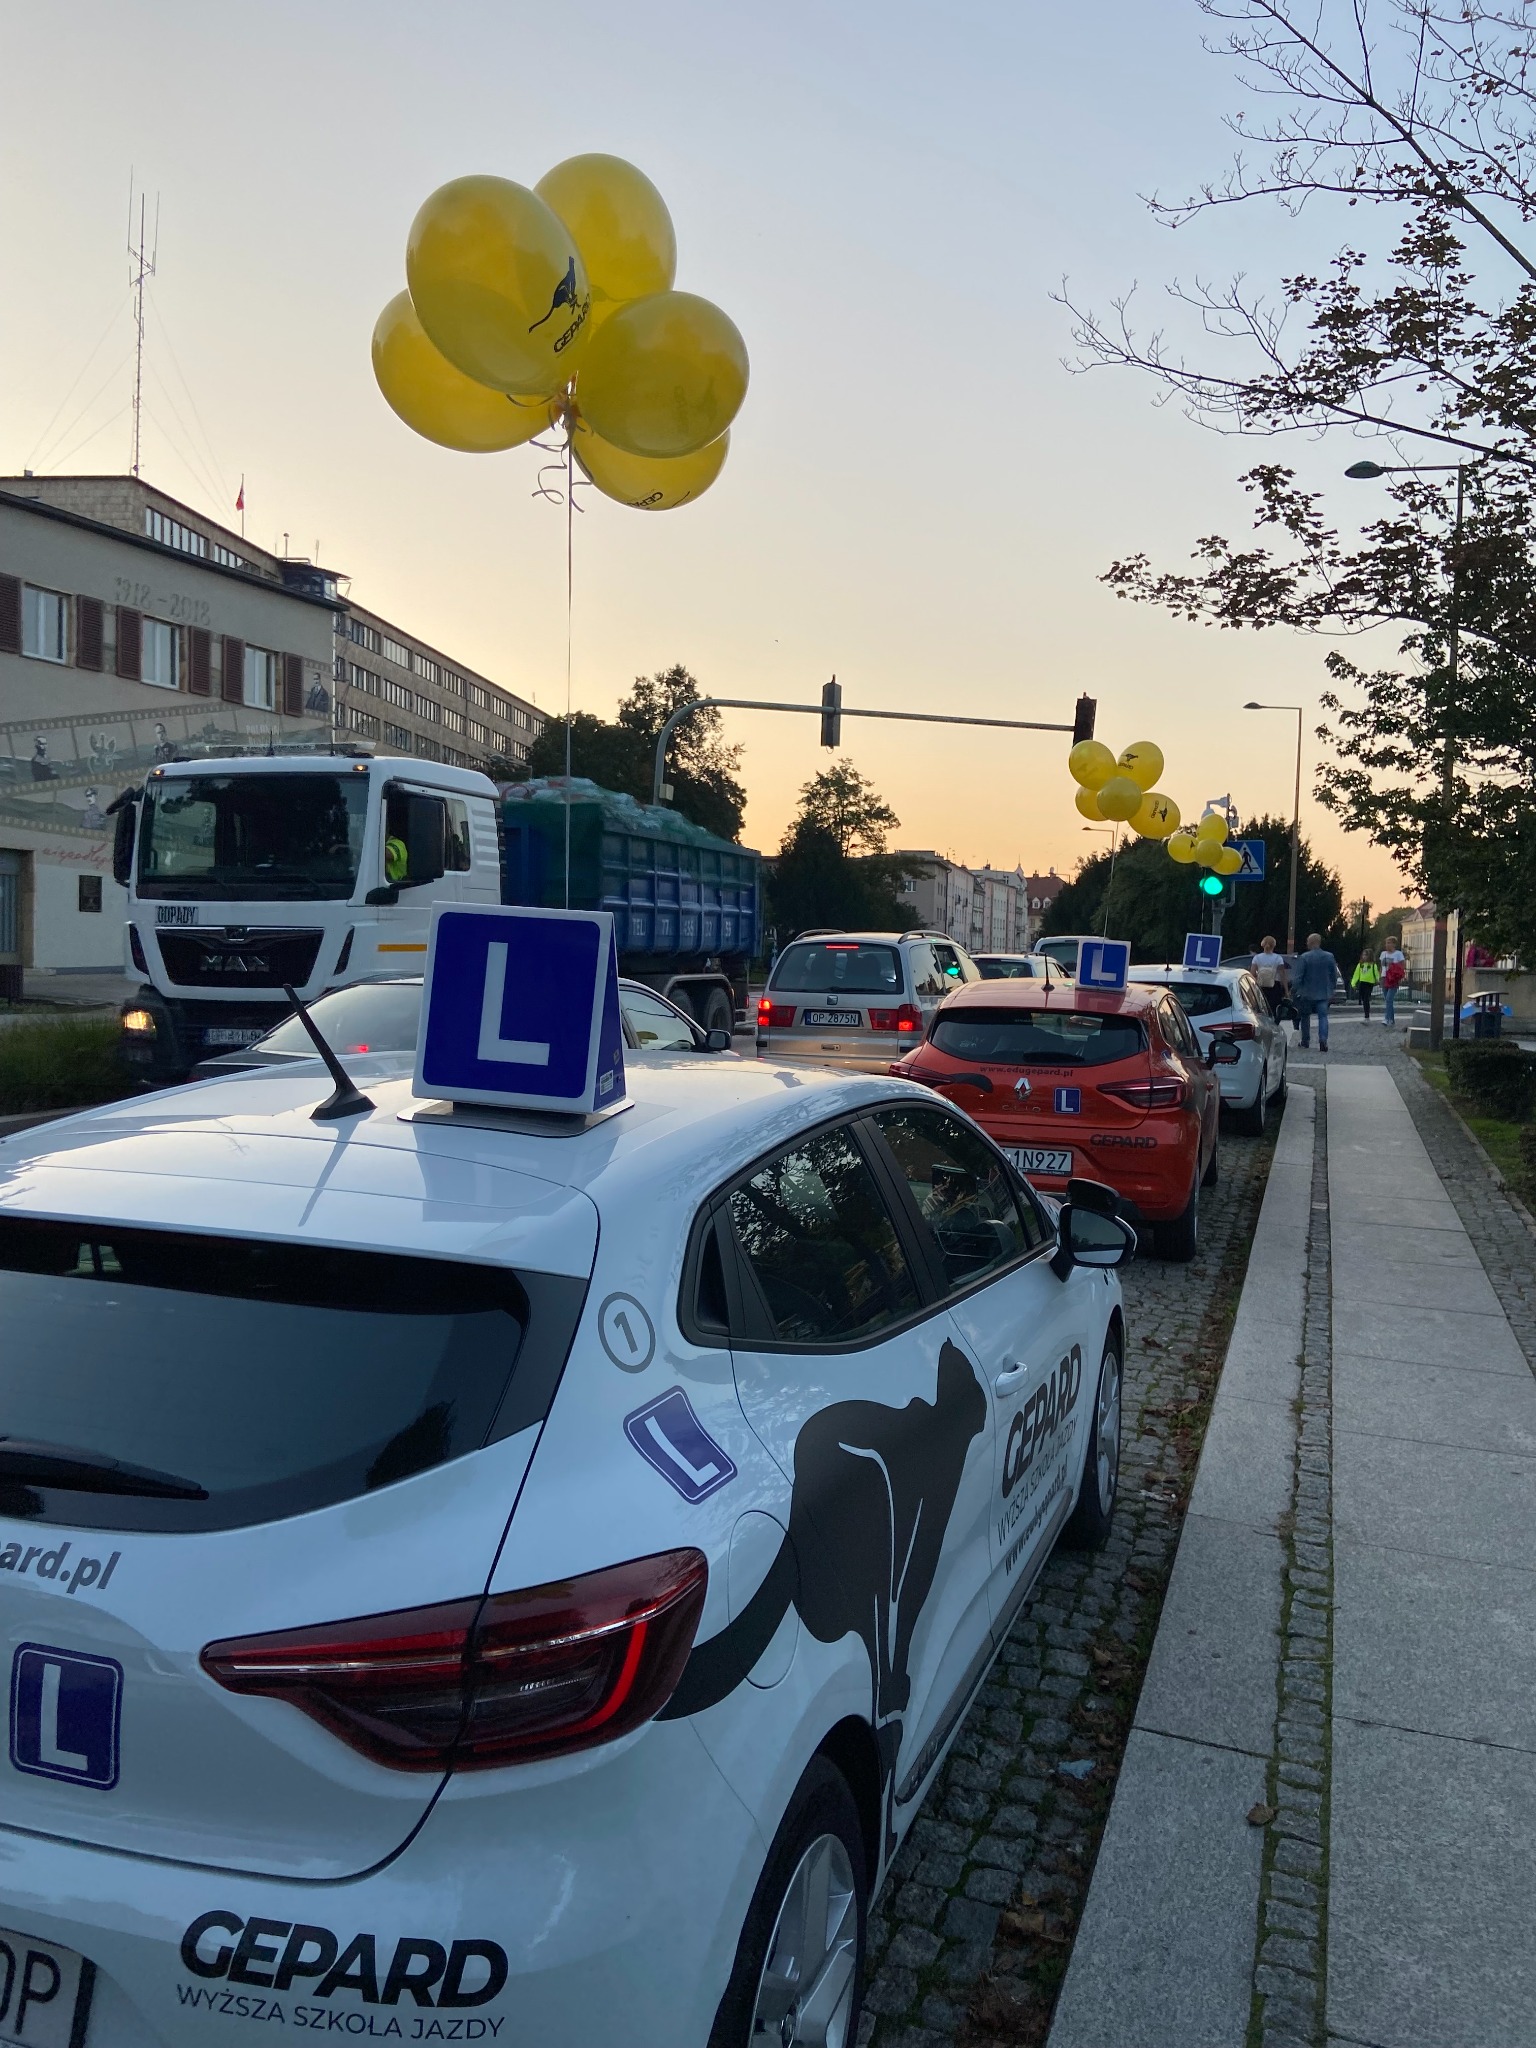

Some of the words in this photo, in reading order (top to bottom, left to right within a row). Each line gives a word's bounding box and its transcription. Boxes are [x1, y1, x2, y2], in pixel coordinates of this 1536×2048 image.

[157, 905, 196, 924] ODPADY
[201, 955, 270, 972] MAN
[1090, 949, 1117, 982] L
[1195, 940, 1211, 963] L
[477, 942, 551, 1066] L
[812, 1013, 825, 1023] OP
[828, 1014, 857, 1024] 2875N
[980, 1065, 1074, 1078] www.edugepard.pl
[1002, 1104, 1042, 1113] CLIO
[1060, 1090, 1074, 1112] L
[1090, 1133, 1158, 1149] GEPARD
[613, 1311, 639, 1354] 1
[1002, 1342, 1081, 1499] GEPARD
[644, 1415, 721, 1488] L
[997, 1482, 1029, 1546] WYŻSZA
[0, 1542, 122, 1594] ard.pl
[40, 1662, 88, 1772] L
[180, 1909, 509, 2008] GEPARD
[176, 1984, 286, 2025] WYŻSZA
[293, 2006, 403, 2039] SZKOŁA
[410, 2016, 505, 2041] JAZDY
